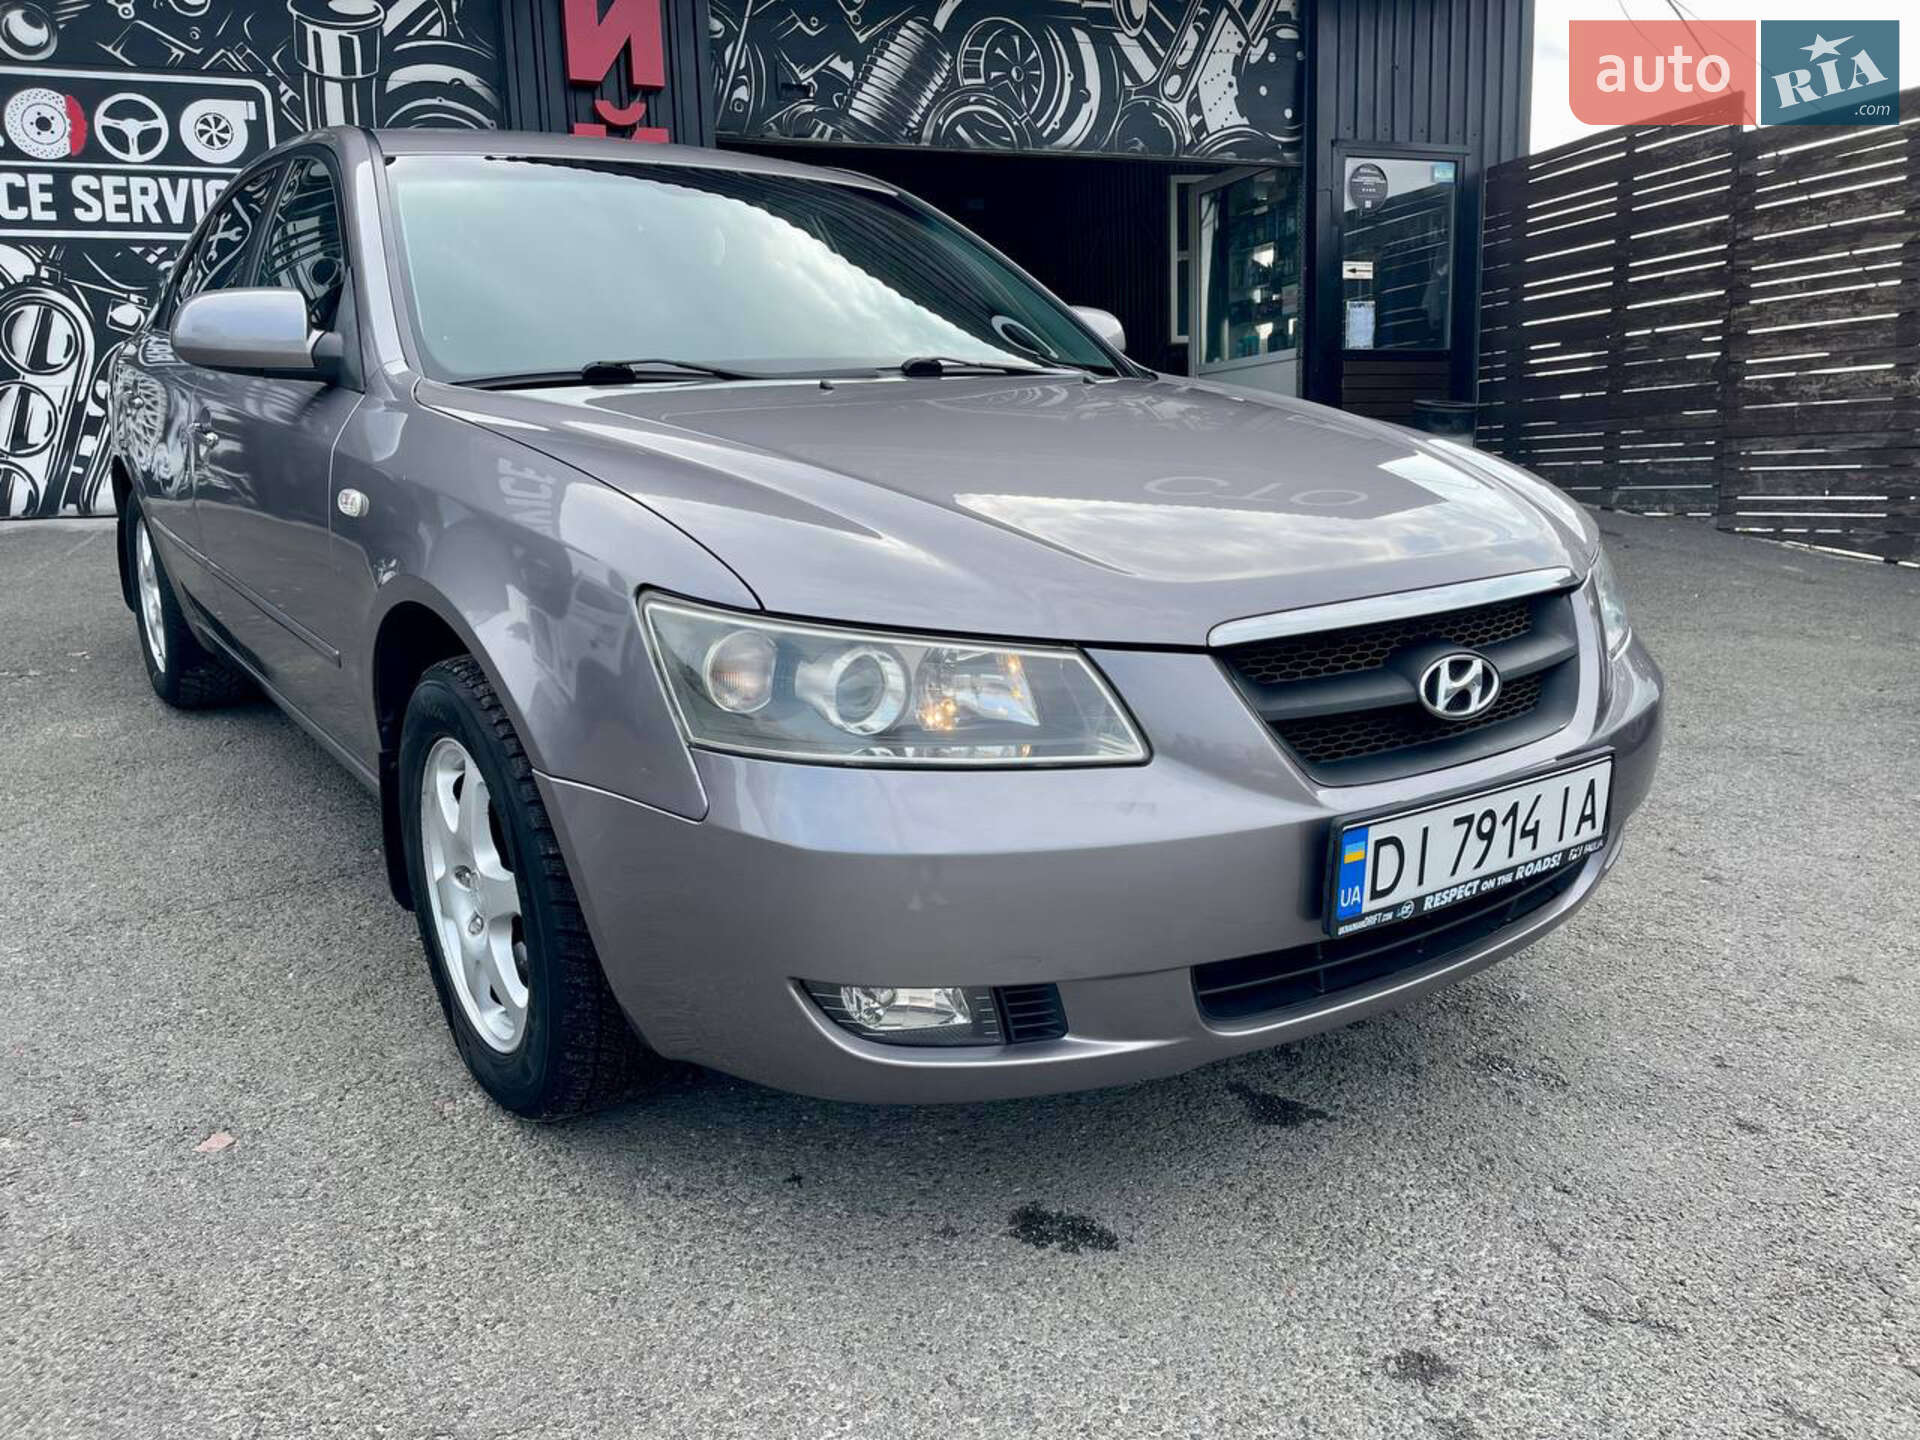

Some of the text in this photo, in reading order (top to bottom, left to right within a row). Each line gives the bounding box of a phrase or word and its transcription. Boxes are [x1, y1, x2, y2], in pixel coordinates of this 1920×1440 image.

[1369, 778, 1597, 901] DI 7914 IA
[1340, 886, 1362, 907] UA
[1423, 880, 1480, 911] RESPECT
[1481, 879, 1496, 891] ON
[1515, 852, 1562, 880] ROADS!
